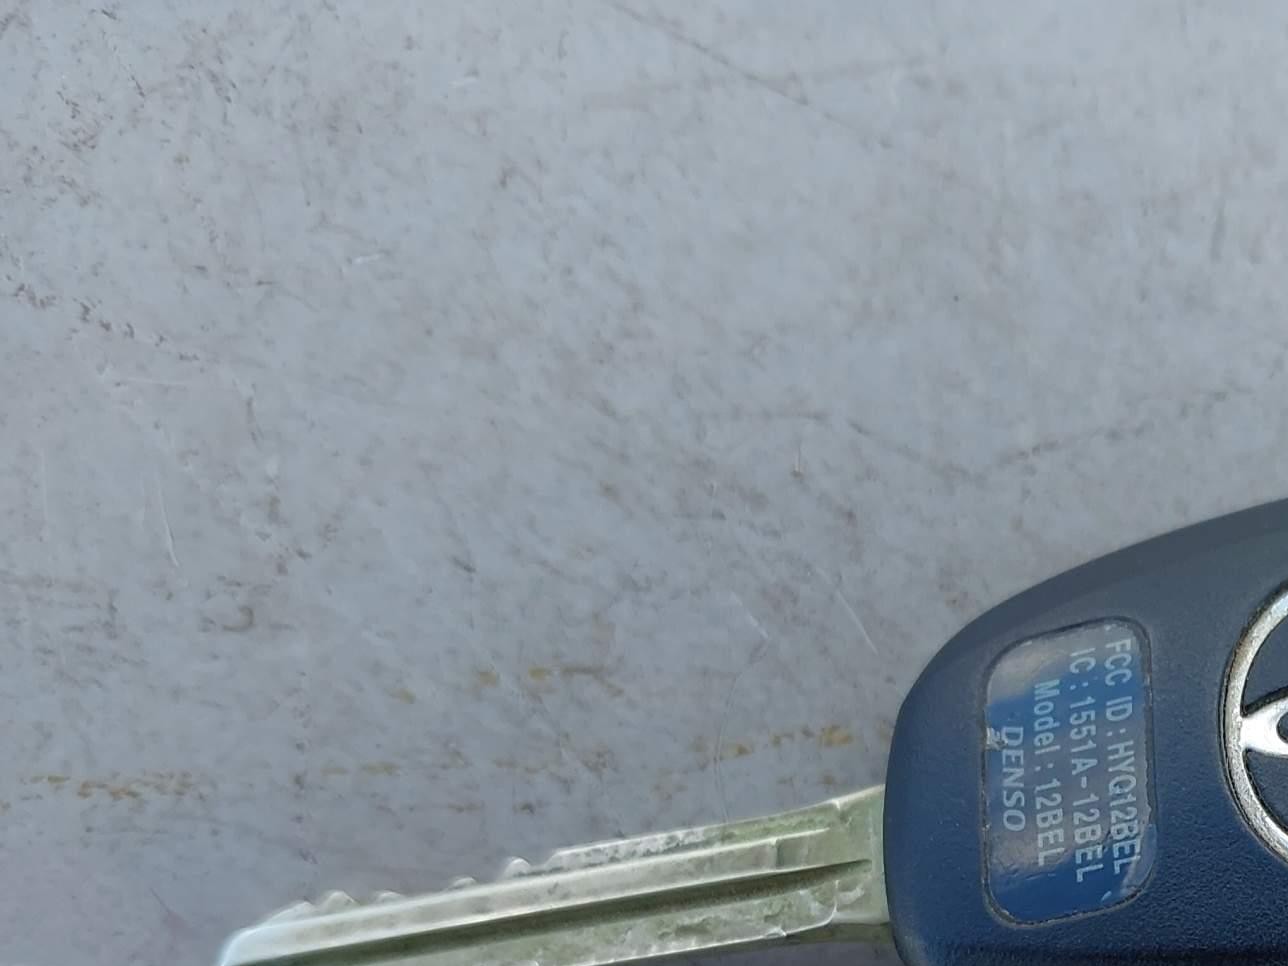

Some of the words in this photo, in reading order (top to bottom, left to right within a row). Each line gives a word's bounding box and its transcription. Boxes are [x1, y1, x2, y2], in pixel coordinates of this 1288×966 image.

[1105, 639, 1133, 687] FCC
[1001, 726, 1026, 832] DENSO
[1035, 778, 1065, 866] 12BEL
